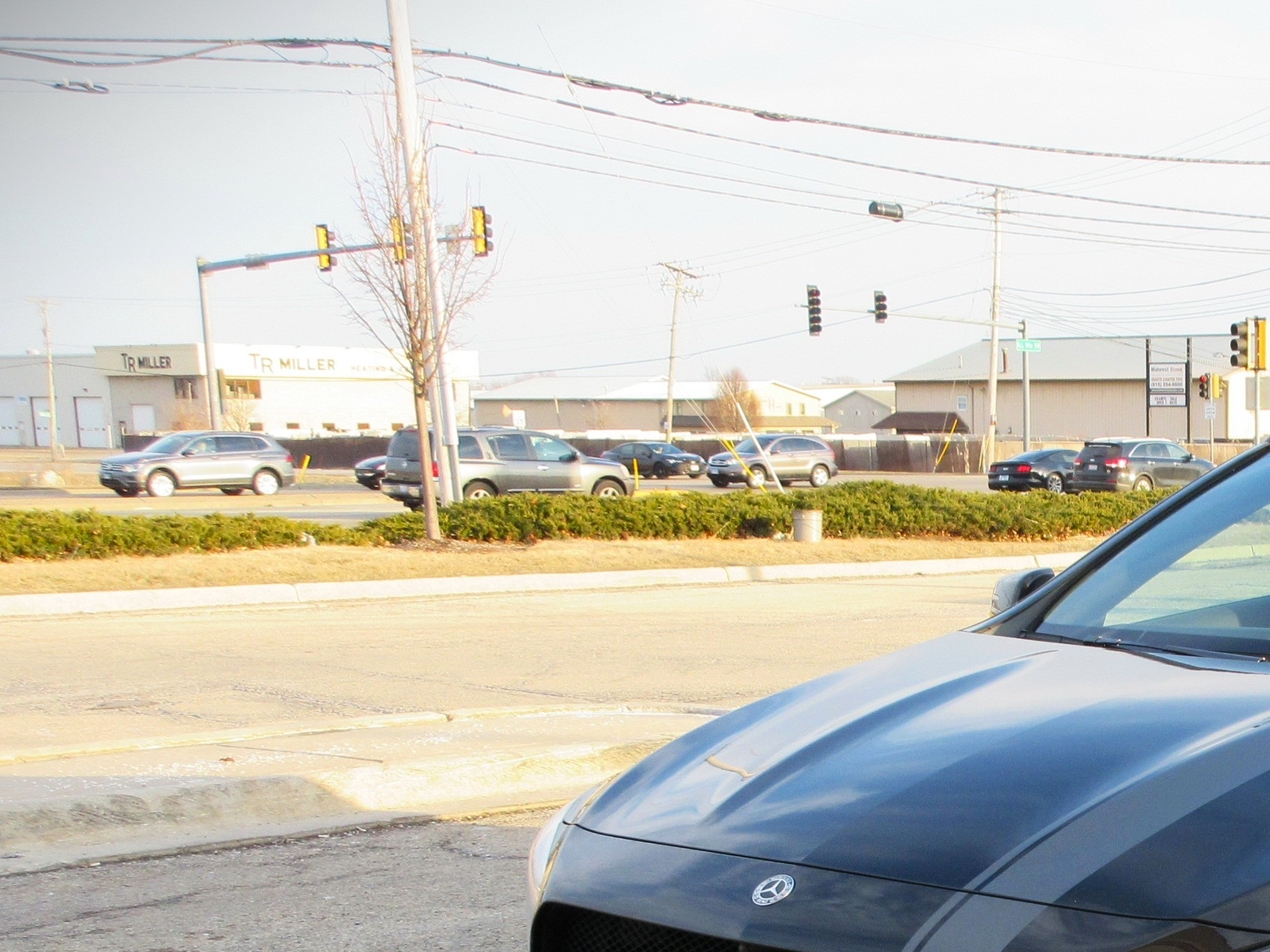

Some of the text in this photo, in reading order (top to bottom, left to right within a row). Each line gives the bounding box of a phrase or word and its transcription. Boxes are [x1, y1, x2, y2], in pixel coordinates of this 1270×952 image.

[138, 356, 172, 369] MILLER
[248, 353, 274, 373] TR
[279, 358, 336, 371] MILLER
